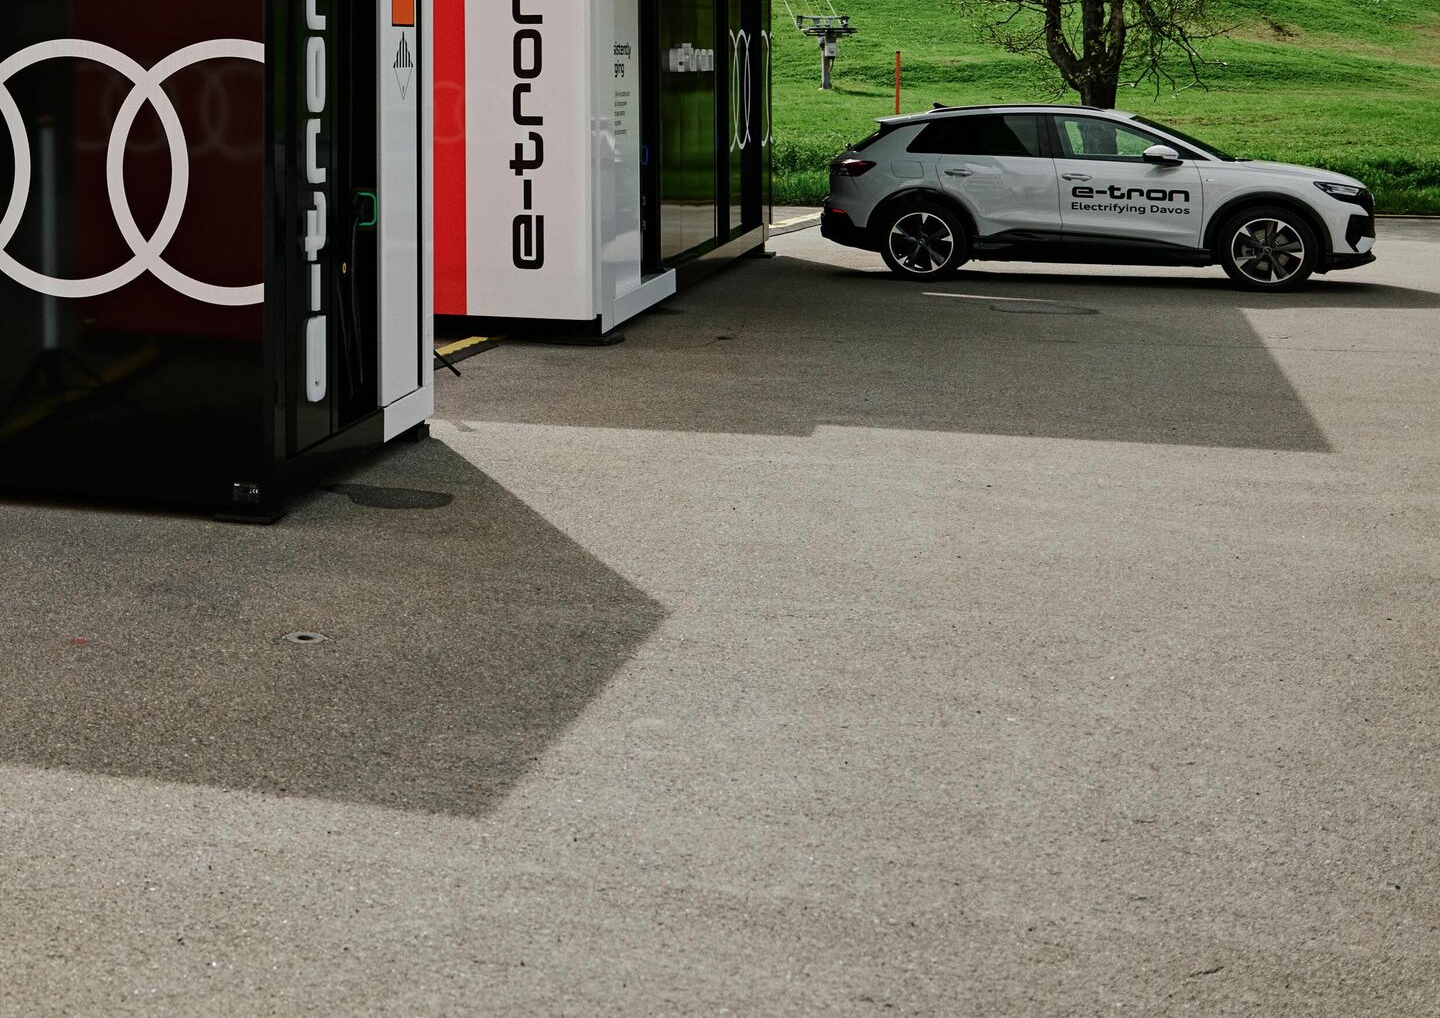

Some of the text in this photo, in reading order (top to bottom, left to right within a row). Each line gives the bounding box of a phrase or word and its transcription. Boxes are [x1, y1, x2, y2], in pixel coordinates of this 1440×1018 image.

[1071, 185, 1190, 202] e-tron
[1071, 202, 1190, 215] Electrifying Davos
